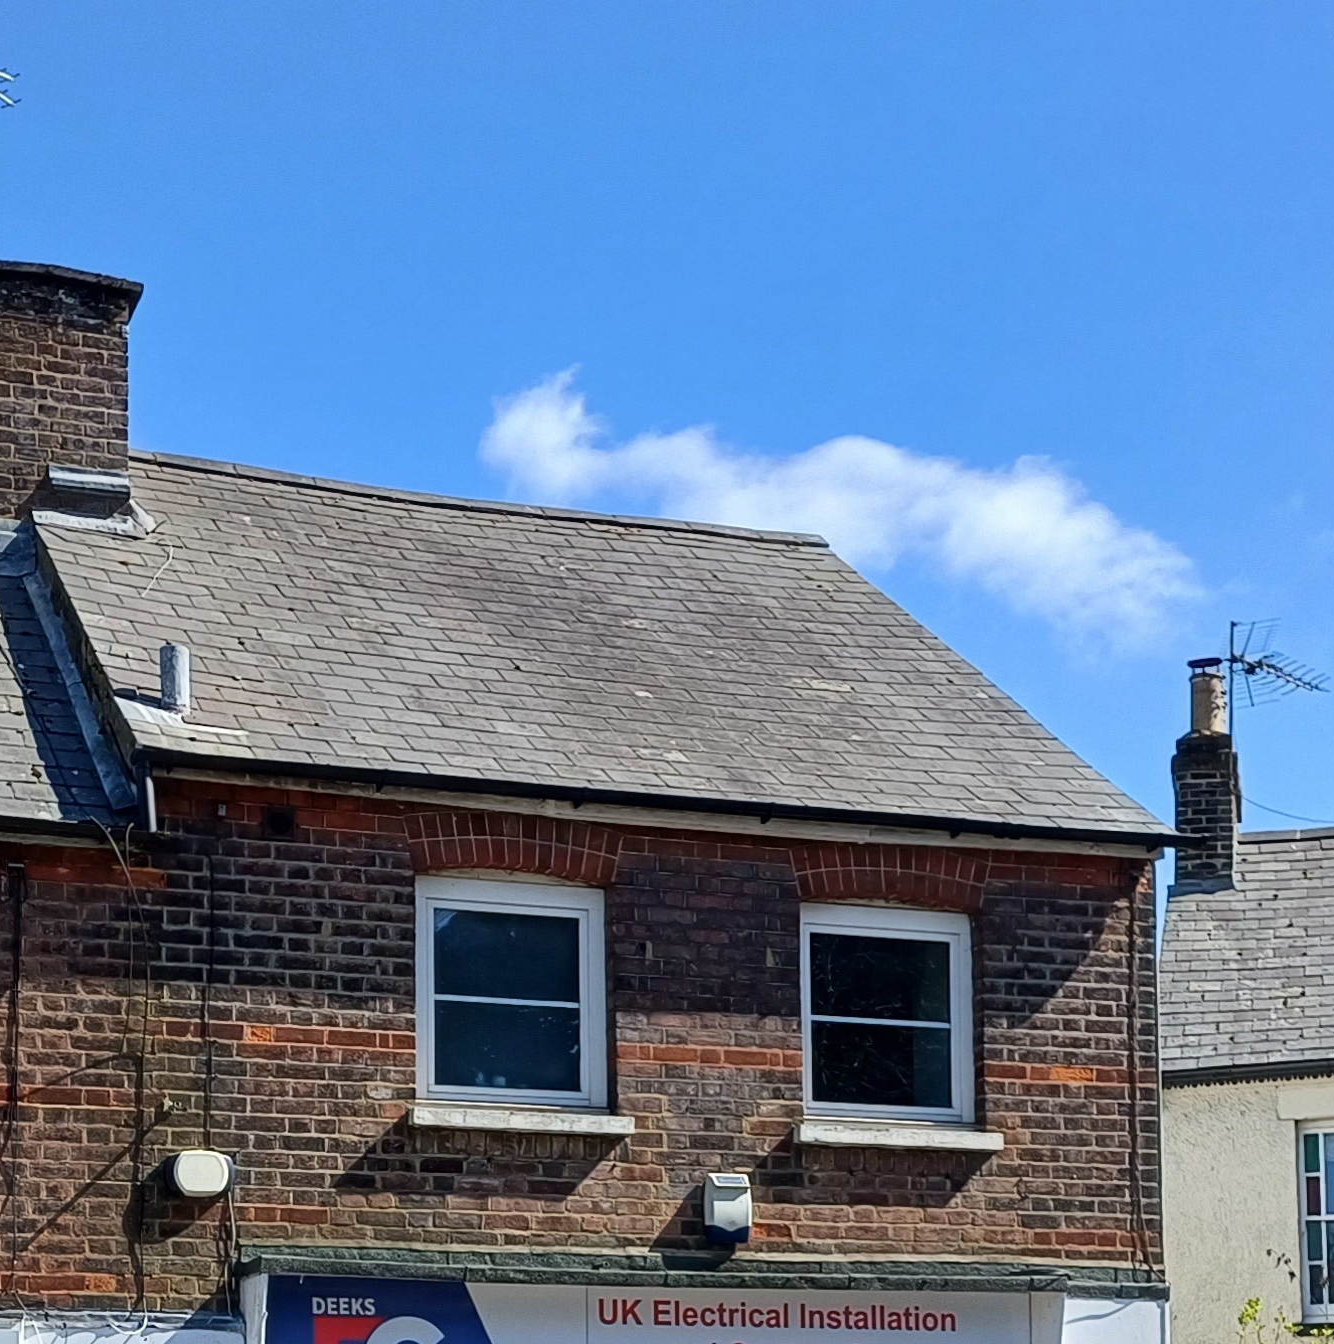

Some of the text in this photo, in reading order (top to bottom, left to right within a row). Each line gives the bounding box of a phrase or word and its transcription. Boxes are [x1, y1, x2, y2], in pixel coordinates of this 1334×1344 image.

[311, 1297, 375, 1316] DEEKS
[598, 1299, 956, 1332] UK Electrical Installation
